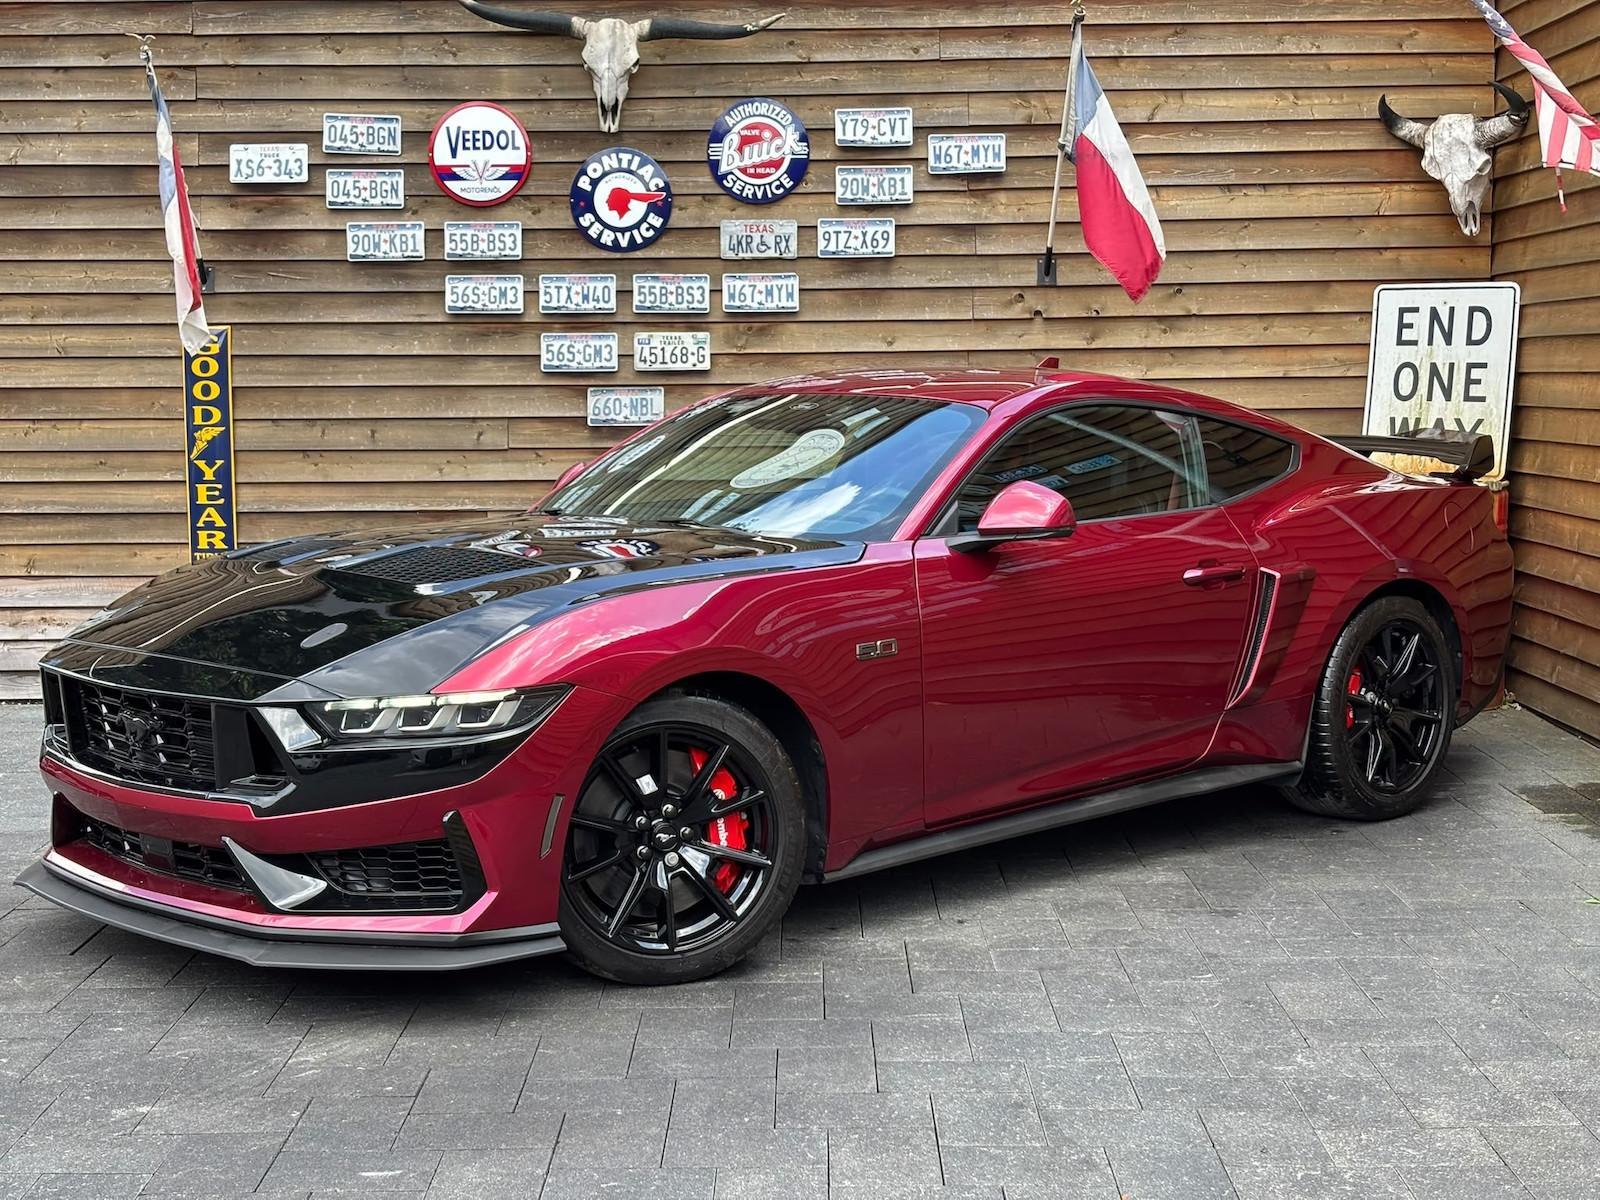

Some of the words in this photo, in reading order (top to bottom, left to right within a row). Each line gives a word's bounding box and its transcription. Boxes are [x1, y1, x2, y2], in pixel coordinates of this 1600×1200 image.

[724, 102, 793, 127] AUTHORIZED
[445, 126, 521, 159] VEEDOL
[718, 123, 805, 175] Buick
[577, 152, 665, 192] PONTIAC
[723, 173, 794, 199] SERVICE
[578, 212, 664, 247] SERVICE
[728, 235, 753, 254] 4KR
[774, 235, 791, 254] RX
[744, 224, 775, 234] TEXAS
[1396, 305, 1493, 347] END
[1392, 361, 1488, 403] ONE
